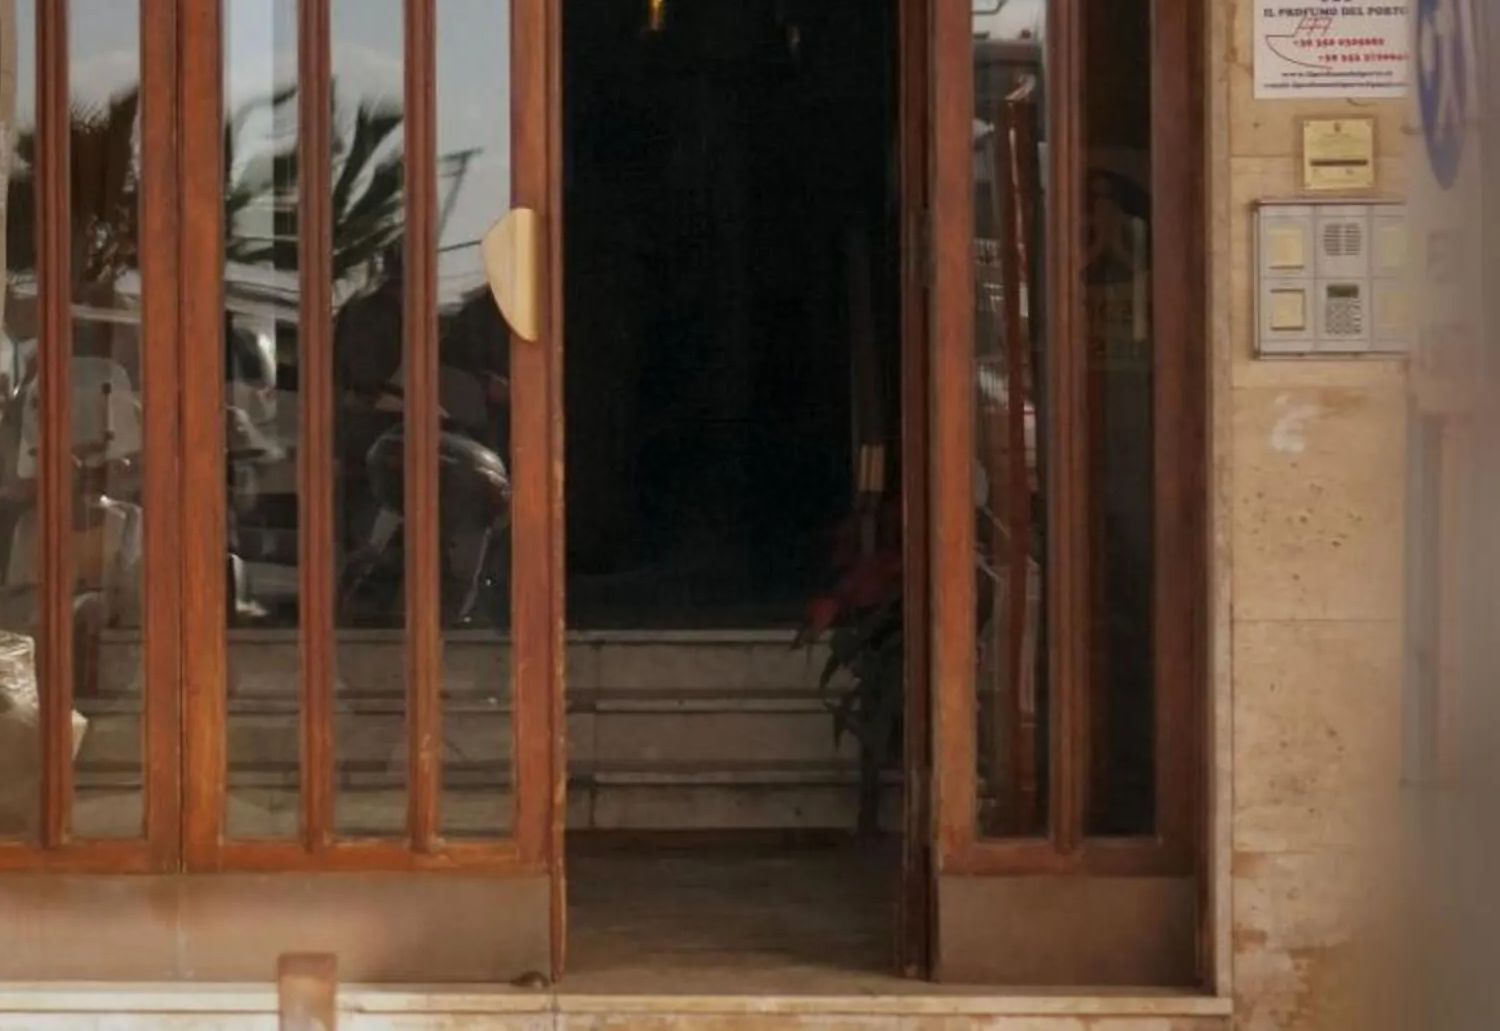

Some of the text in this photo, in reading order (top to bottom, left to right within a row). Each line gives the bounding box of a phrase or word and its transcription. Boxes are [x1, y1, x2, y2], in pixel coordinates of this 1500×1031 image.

[1263, 8, 1276, 17] IL
[1278, 7, 1338, 17] PROFUMO
[1341, 6, 1363, 16] DEL
